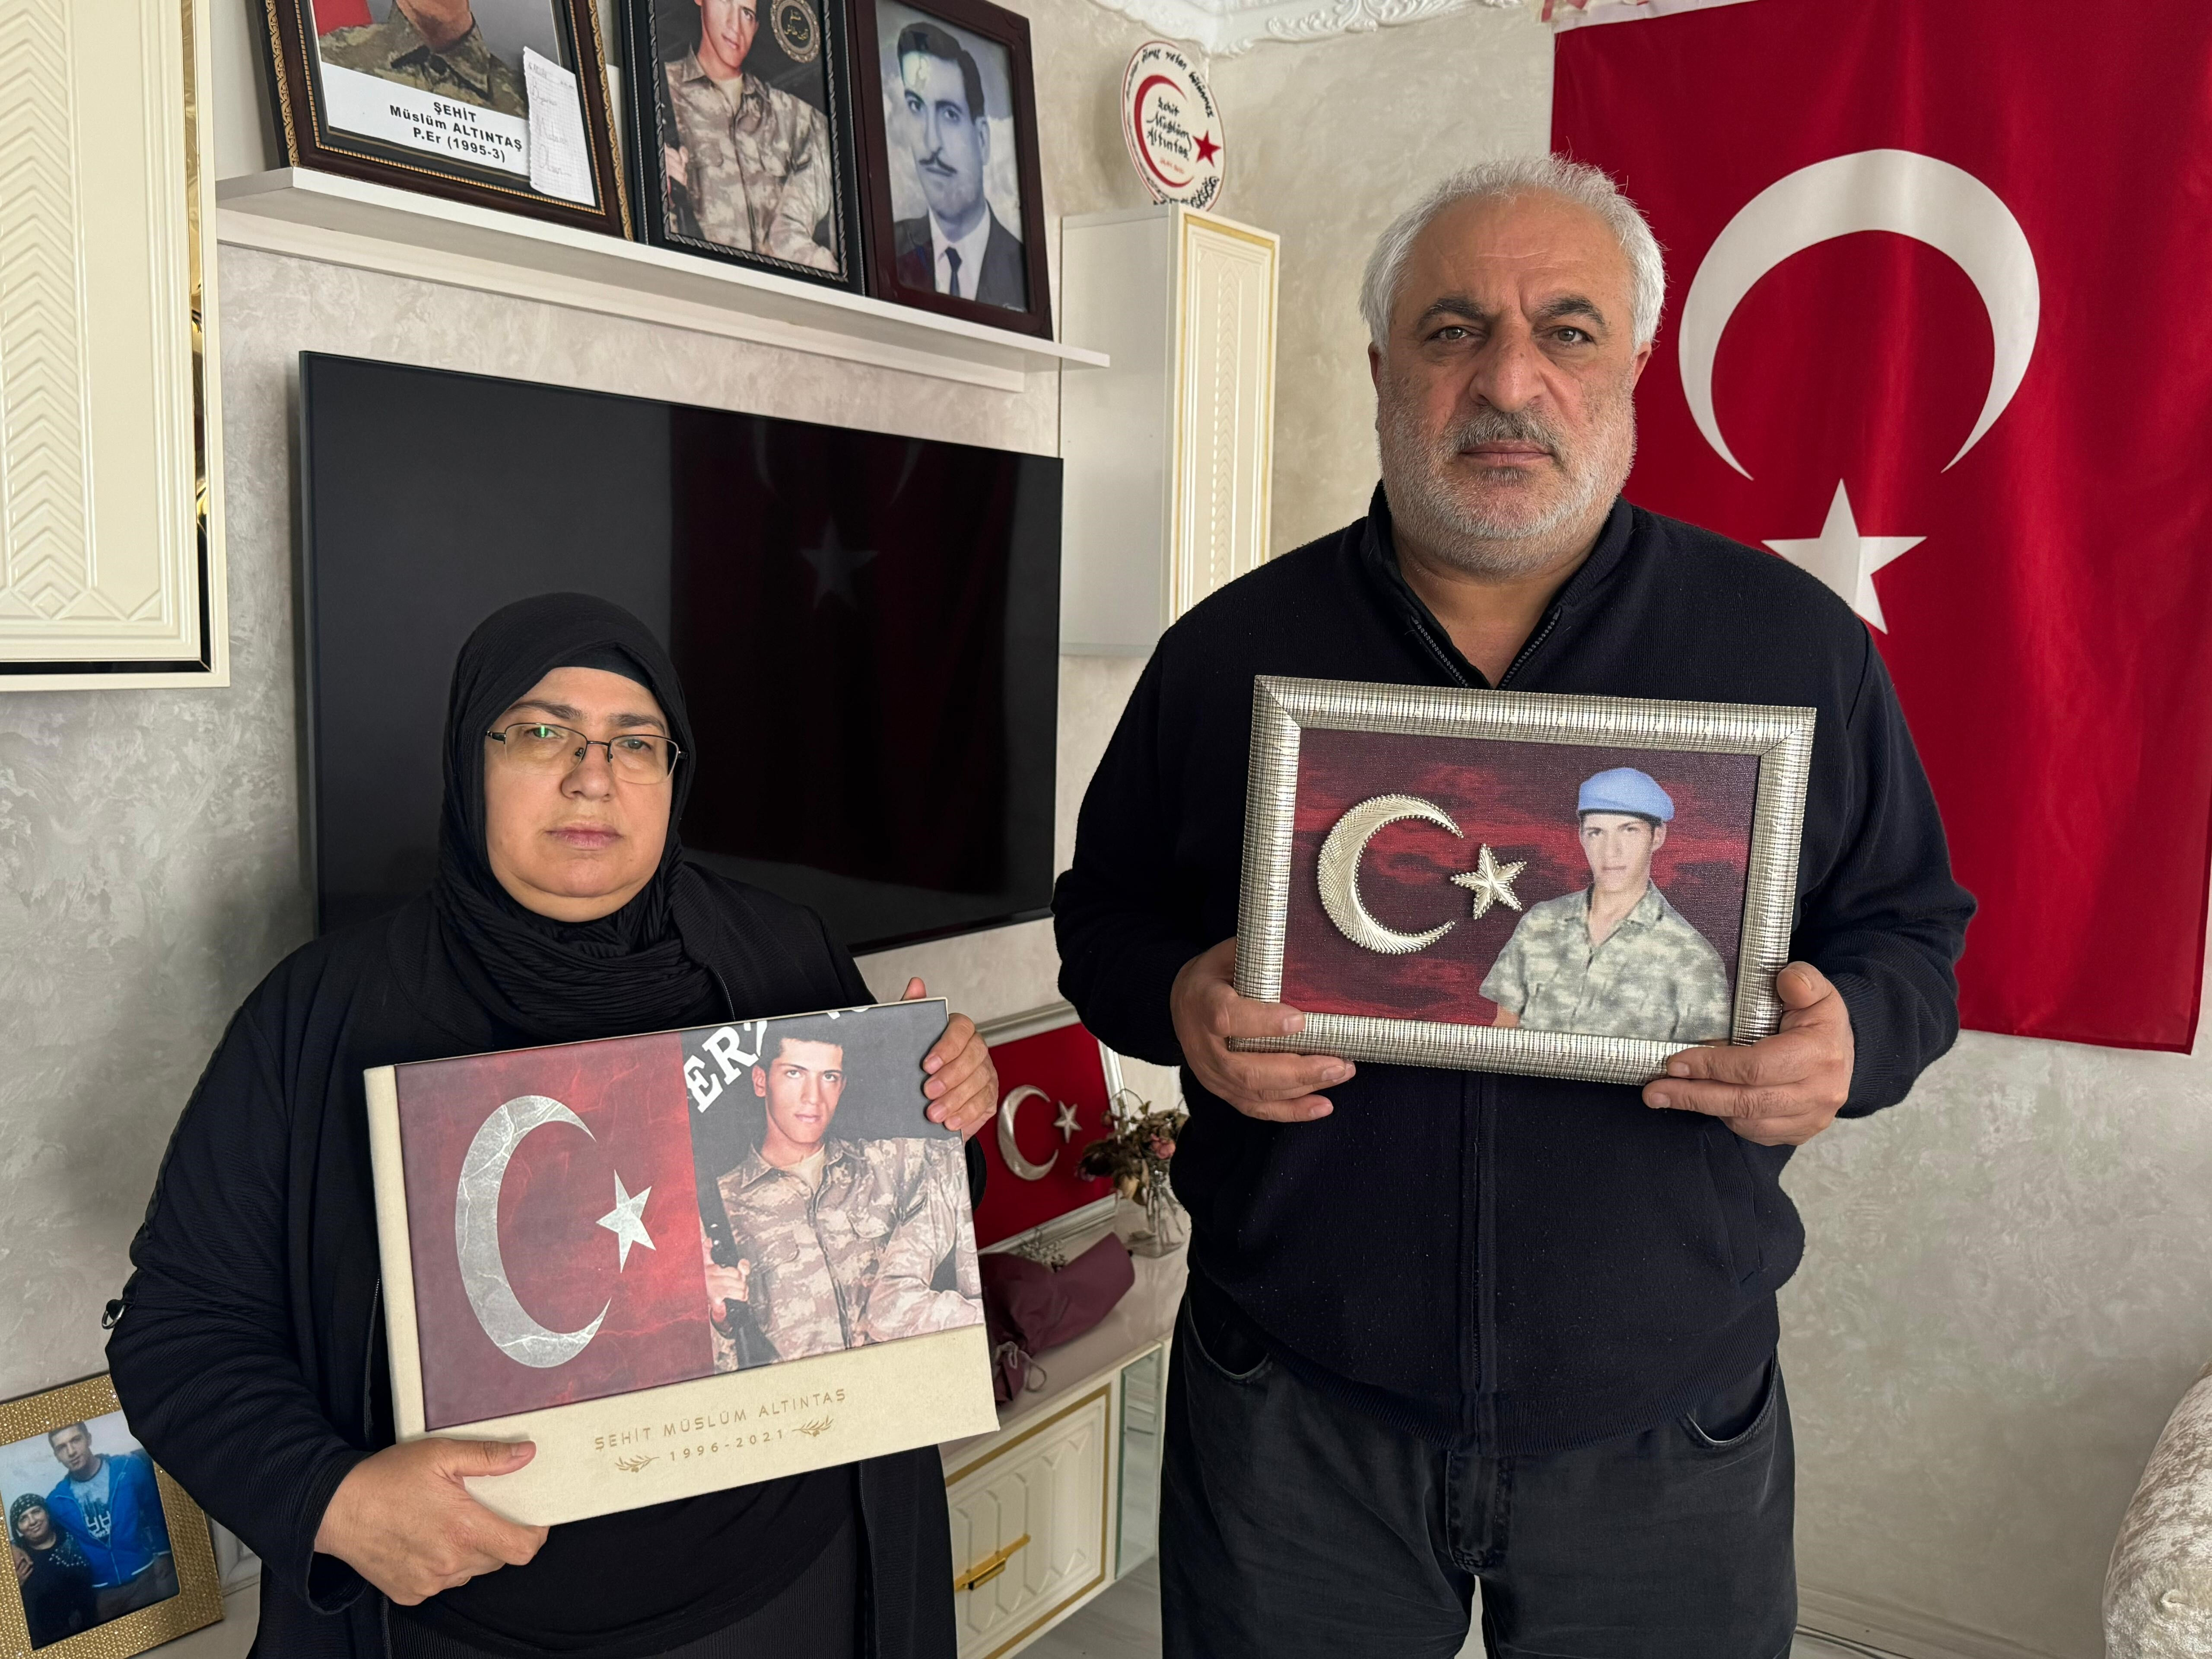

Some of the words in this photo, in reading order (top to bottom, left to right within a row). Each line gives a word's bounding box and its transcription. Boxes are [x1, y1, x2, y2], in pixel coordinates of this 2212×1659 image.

[390, 105, 447, 130] Müslüm
[453, 123, 522, 152] ALTINTAŞ
[433, 102, 477, 123] ŞEHİT
[413, 127, 441, 144] P.Er
[448, 136, 505, 163] (1995-3)
[664, 1409, 747, 1437] MÜSLÜM
[671, 1429, 782, 1461] 1996-2021
